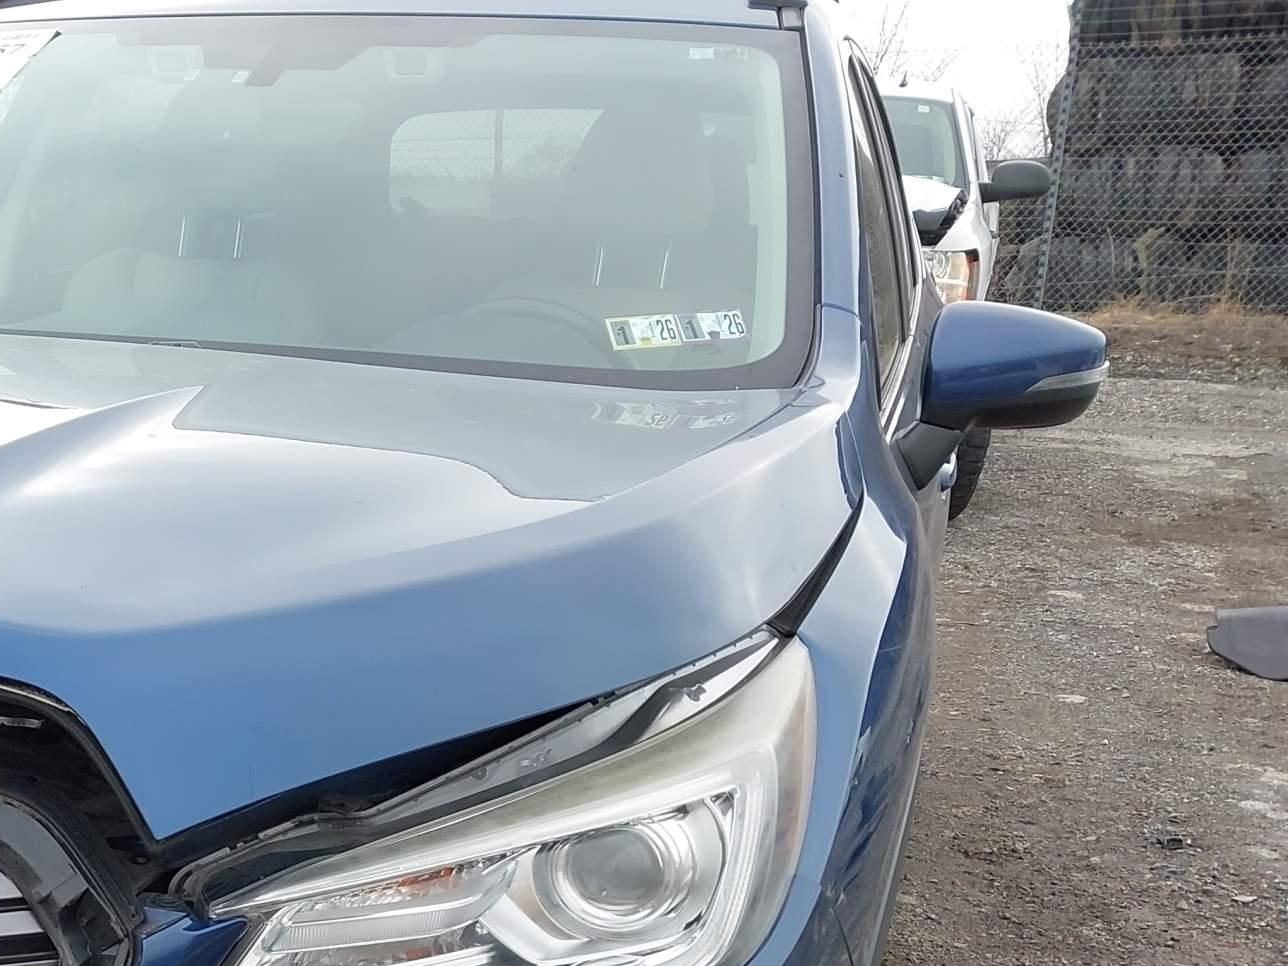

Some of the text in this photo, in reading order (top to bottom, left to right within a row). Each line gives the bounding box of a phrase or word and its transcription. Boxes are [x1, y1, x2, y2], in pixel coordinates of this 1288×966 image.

[617, 319, 677, 345] 1 26
[684, 313, 745, 339] 1 26
